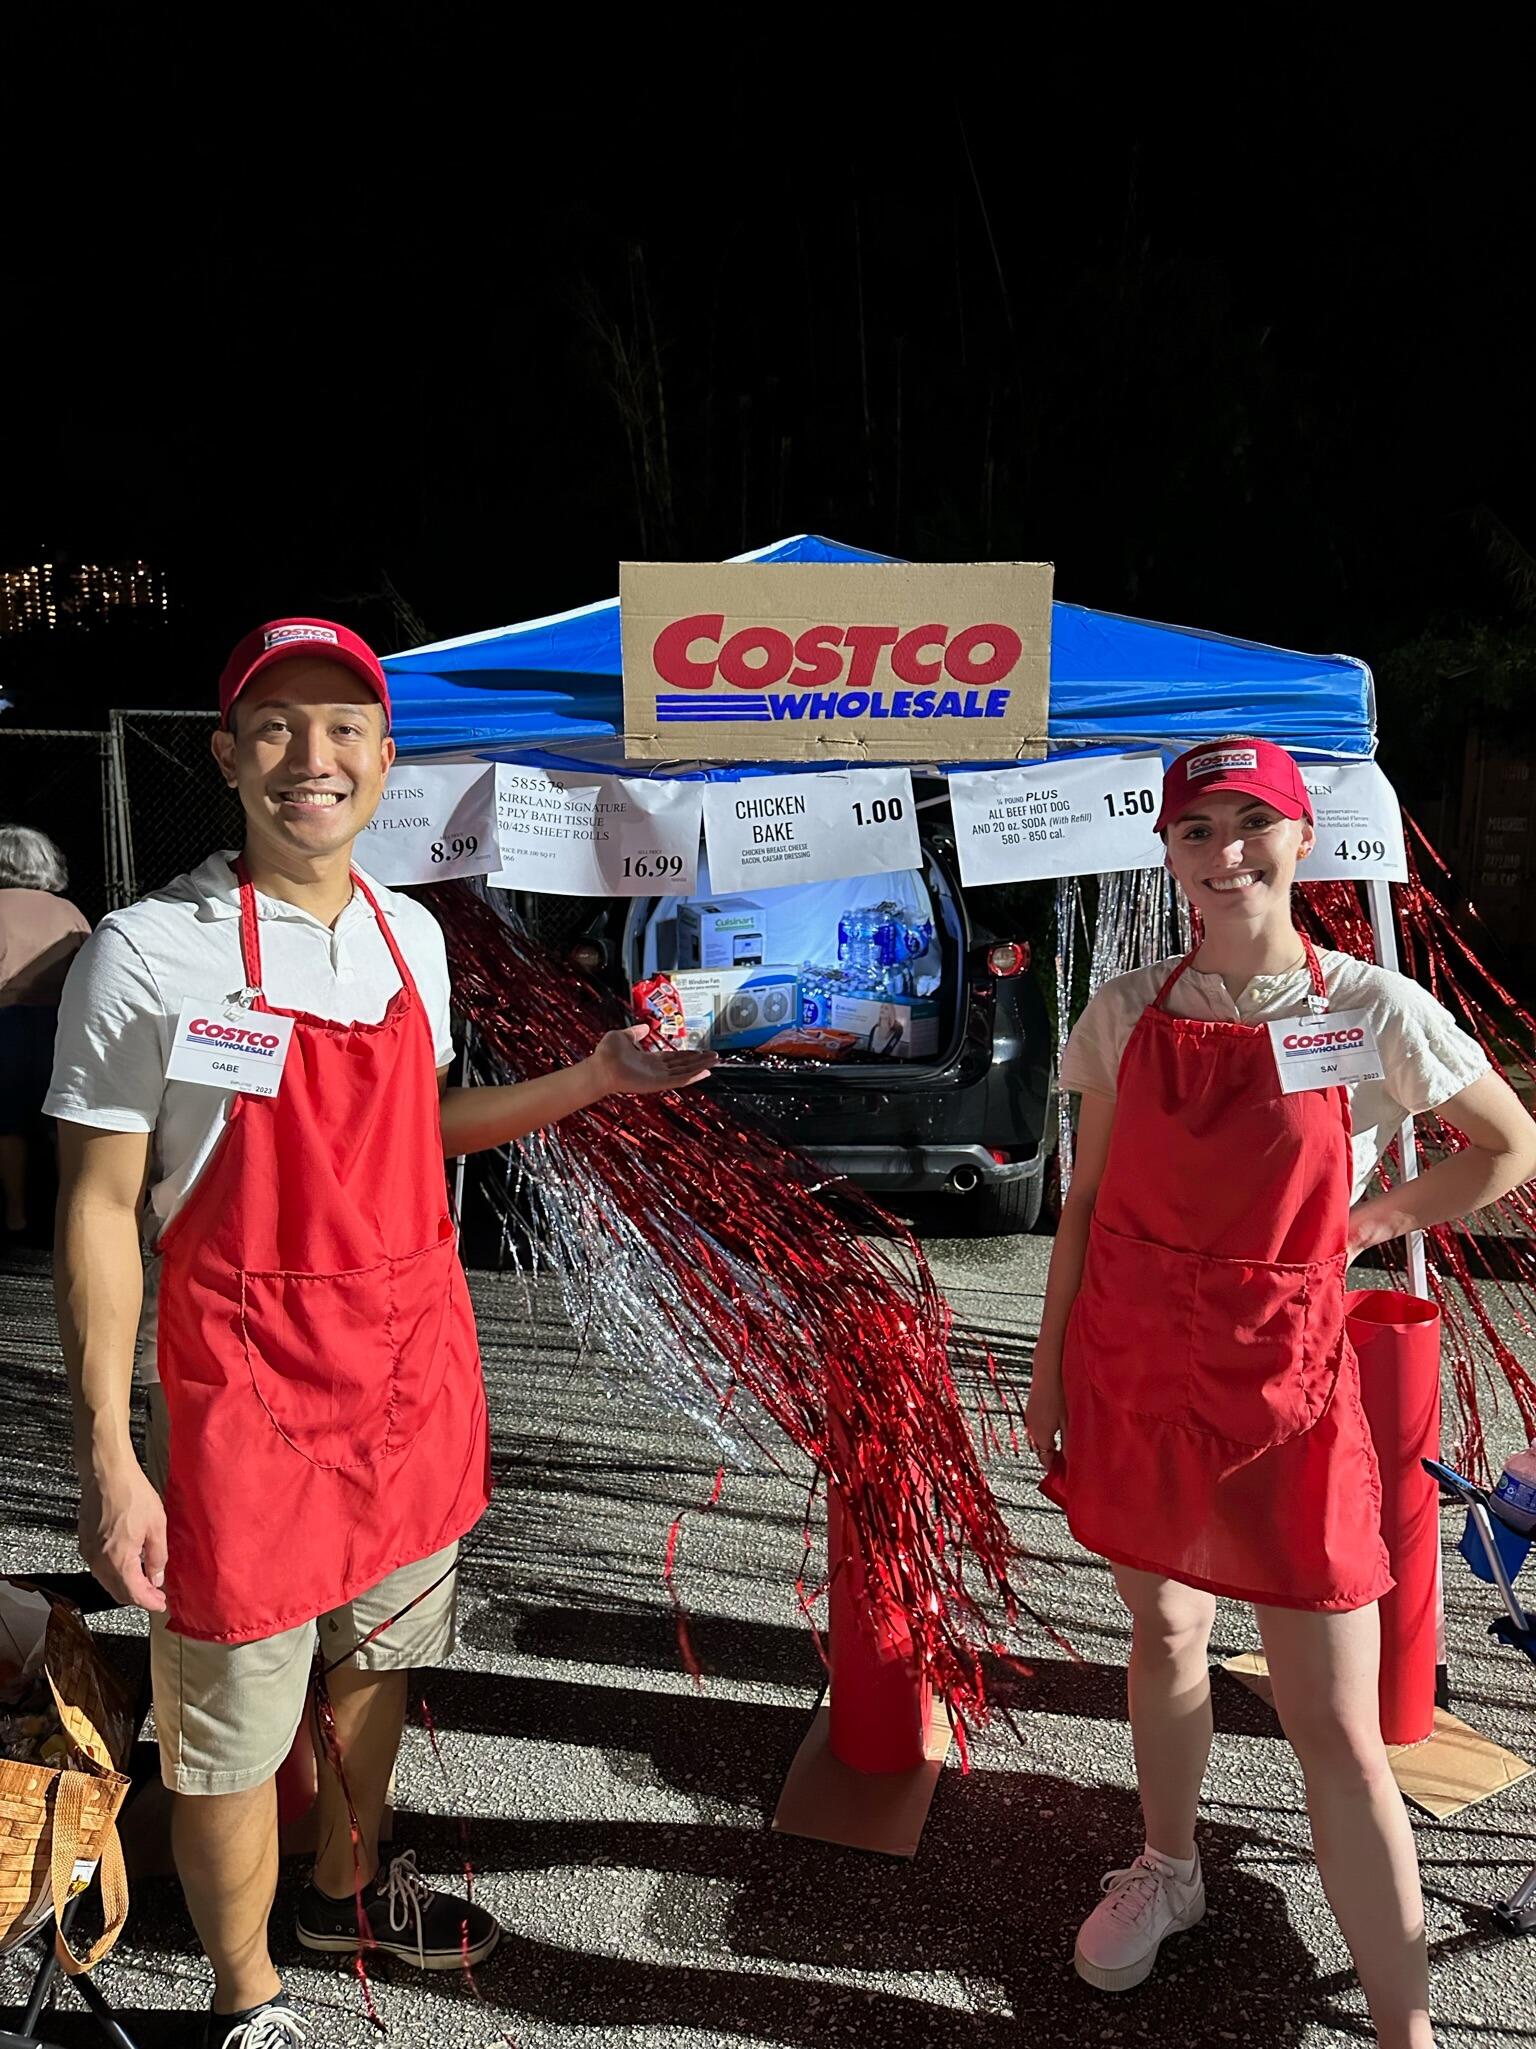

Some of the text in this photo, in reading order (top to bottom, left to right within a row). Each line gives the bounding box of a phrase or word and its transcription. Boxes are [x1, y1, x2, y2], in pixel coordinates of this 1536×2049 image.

[268, 629, 334, 641] COSTCO
[653, 614, 1022, 690] COSTCO
[768, 690, 1010, 721] WHOLESALE
[1190, 753, 1254, 770] COSTCO
[380, 788, 424, 800] UFFINS
[511, 776, 564, 795] 585578
[1304, 785, 1332, 795] KEN
[499, 792, 627, 813] KIRKLAND SIGNATURE
[1004, 796, 1024, 805] POUND
[1025, 789, 1058, 802] PLUS
[1104, 789, 1155, 818] 1.50
[498, 806, 604, 827] 2 PLY BATH TISSUE
[735, 795, 806, 819] CHICKEN
[852, 797, 903, 826] 1.00
[988, 800, 1070, 820] ALL BEEF HOT DOG
[383, 817, 430, 829] FLAVOR
[497, 821, 610, 840] 30/425 SHEET ROLLS
[972, 813, 1092, 835] AND 20 oz. SODA (With Refill)
[752, 822, 795, 844] BAKE
[1001, 833, 1020, 845] 580
[1028, 830, 1047, 841] 850
[1049, 829, 1066, 840] cal.
[430, 836, 478, 863] 8.99
[741, 848, 765, 857] CHICKEN
[788, 843, 808, 852] CHEESE
[763, 854, 783, 863] CAESAR
[784, 851, 811, 860] DRESSING
[1334, 839, 1385, 861] 4.99
[623, 855, 683, 878] 16.99
[715, 916, 754, 927] Cuisinart
[189, 1018, 279, 1049] COSTCO
[1283, 1028, 1364, 1050] COSTCO
[214, 1040, 275, 1057] WHOLESALE
[1310, 1041, 1364, 1055] WHOLESALE
[212, 1061, 240, 1073] GABE
[1321, 1064, 1338, 1073] SAV
[1363, 1072, 1379, 1080] 2023
[255, 1086, 272, 1094] 2023
